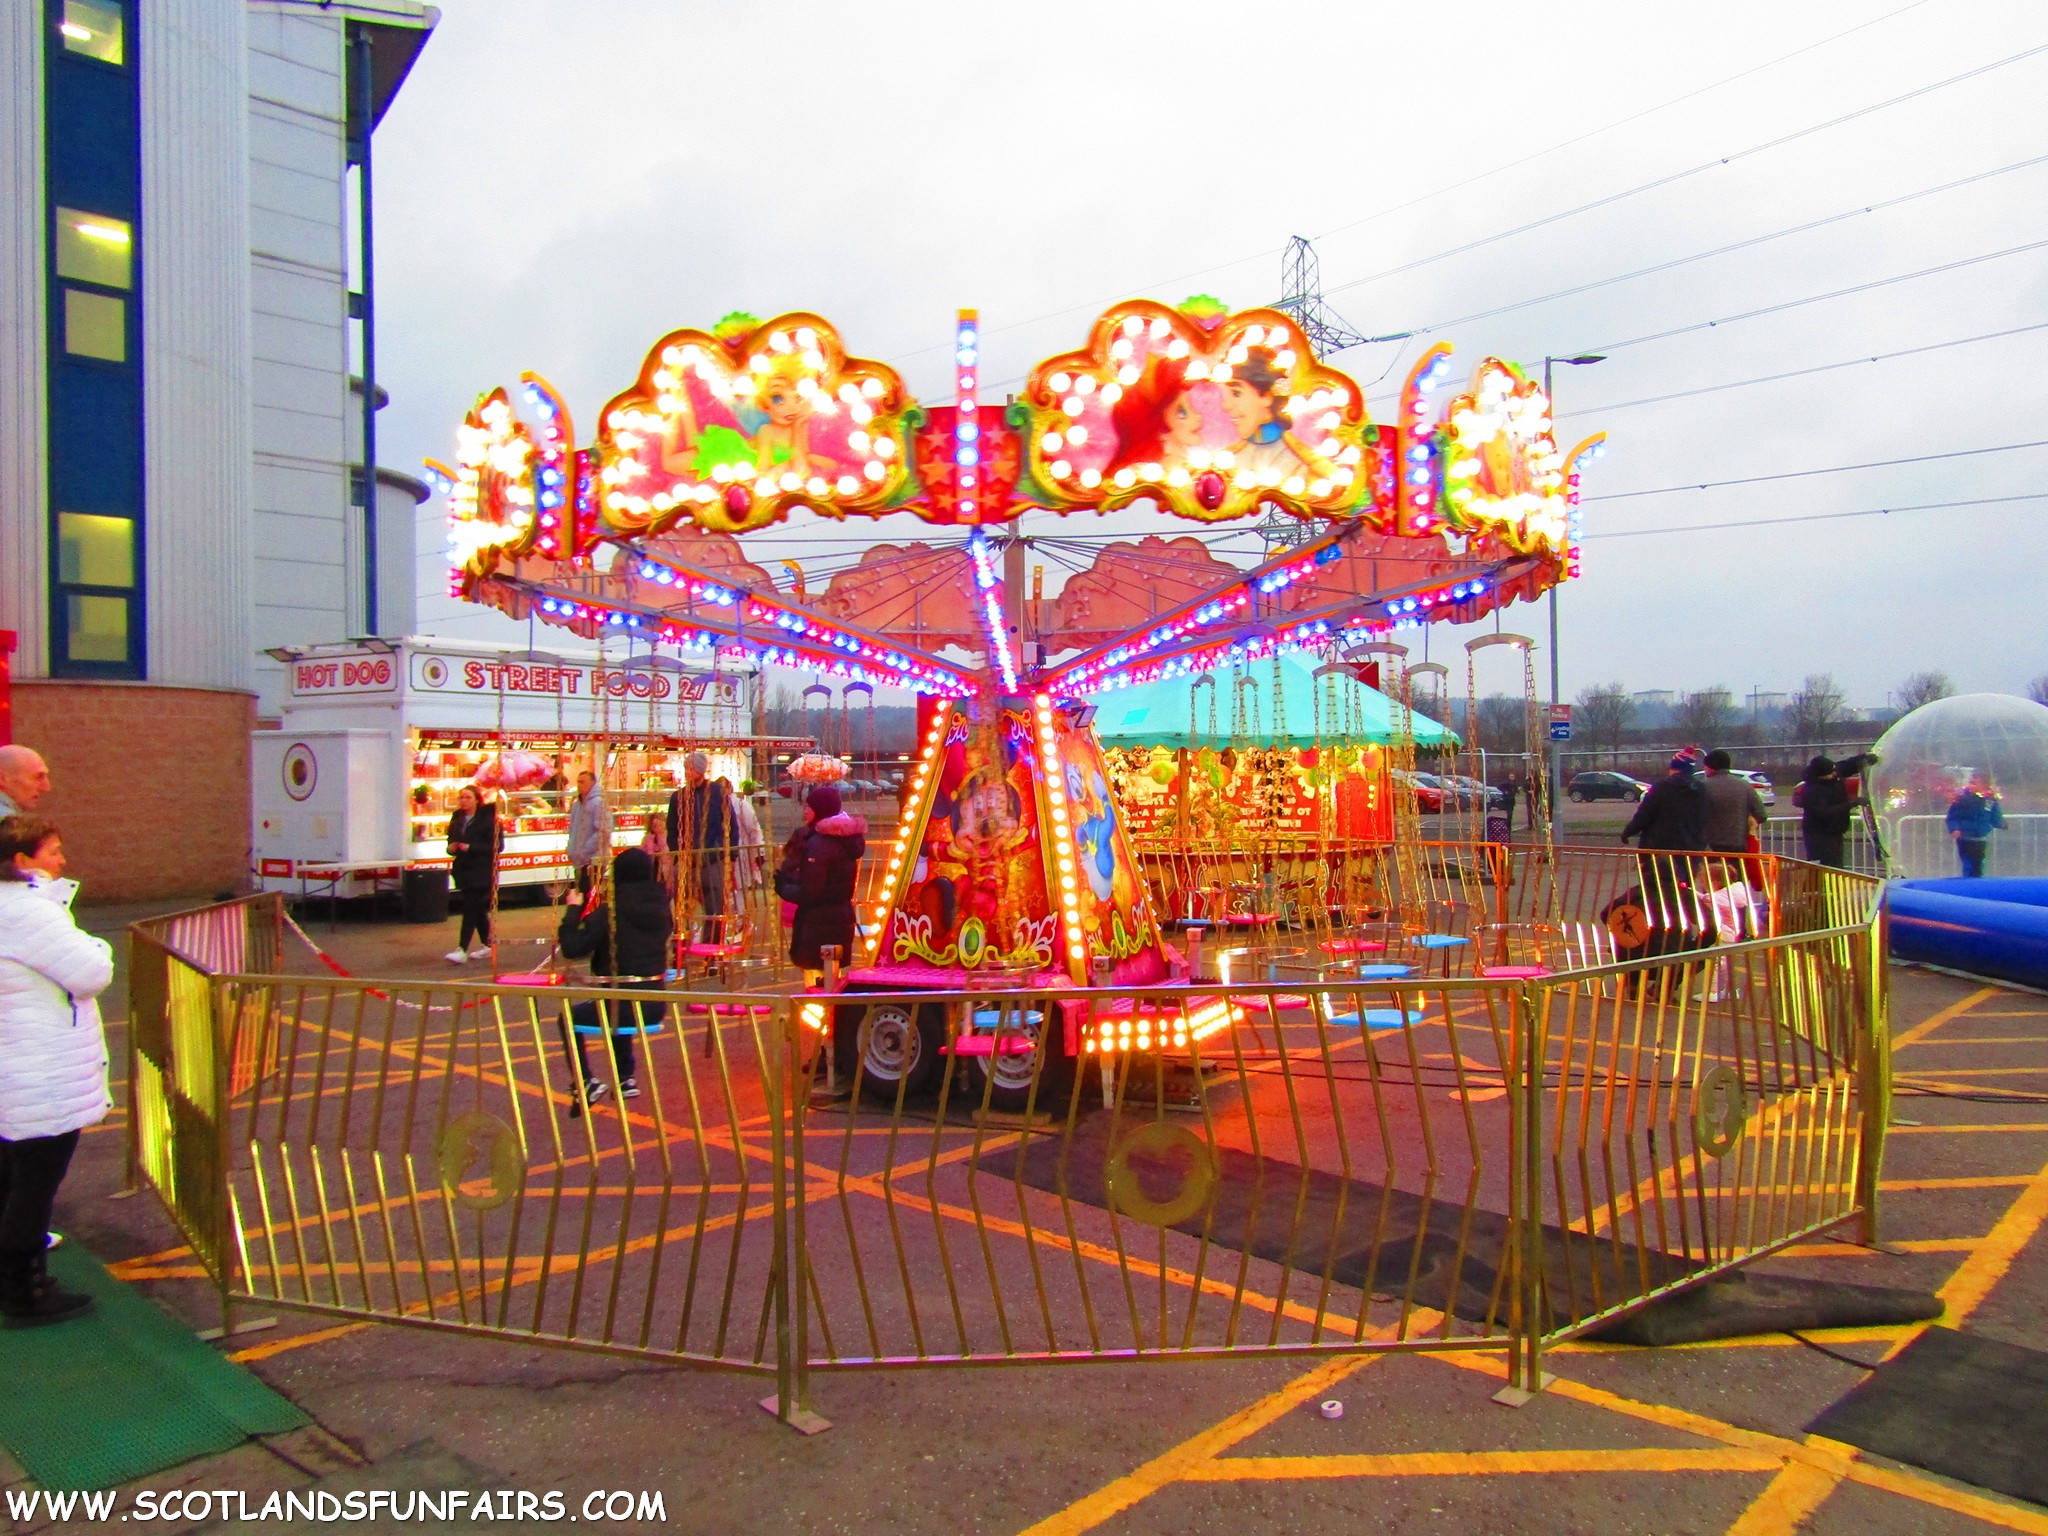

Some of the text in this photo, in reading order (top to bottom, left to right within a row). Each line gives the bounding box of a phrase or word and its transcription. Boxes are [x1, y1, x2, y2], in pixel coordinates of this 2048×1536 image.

[297, 660, 391, 688] HOT DOG
[464, 661, 583, 693] STREET
[591, 671, 670, 699] FOOD
[501, 733, 562, 741] AMERICANO
[533, 855, 553, 864] CHIPS
